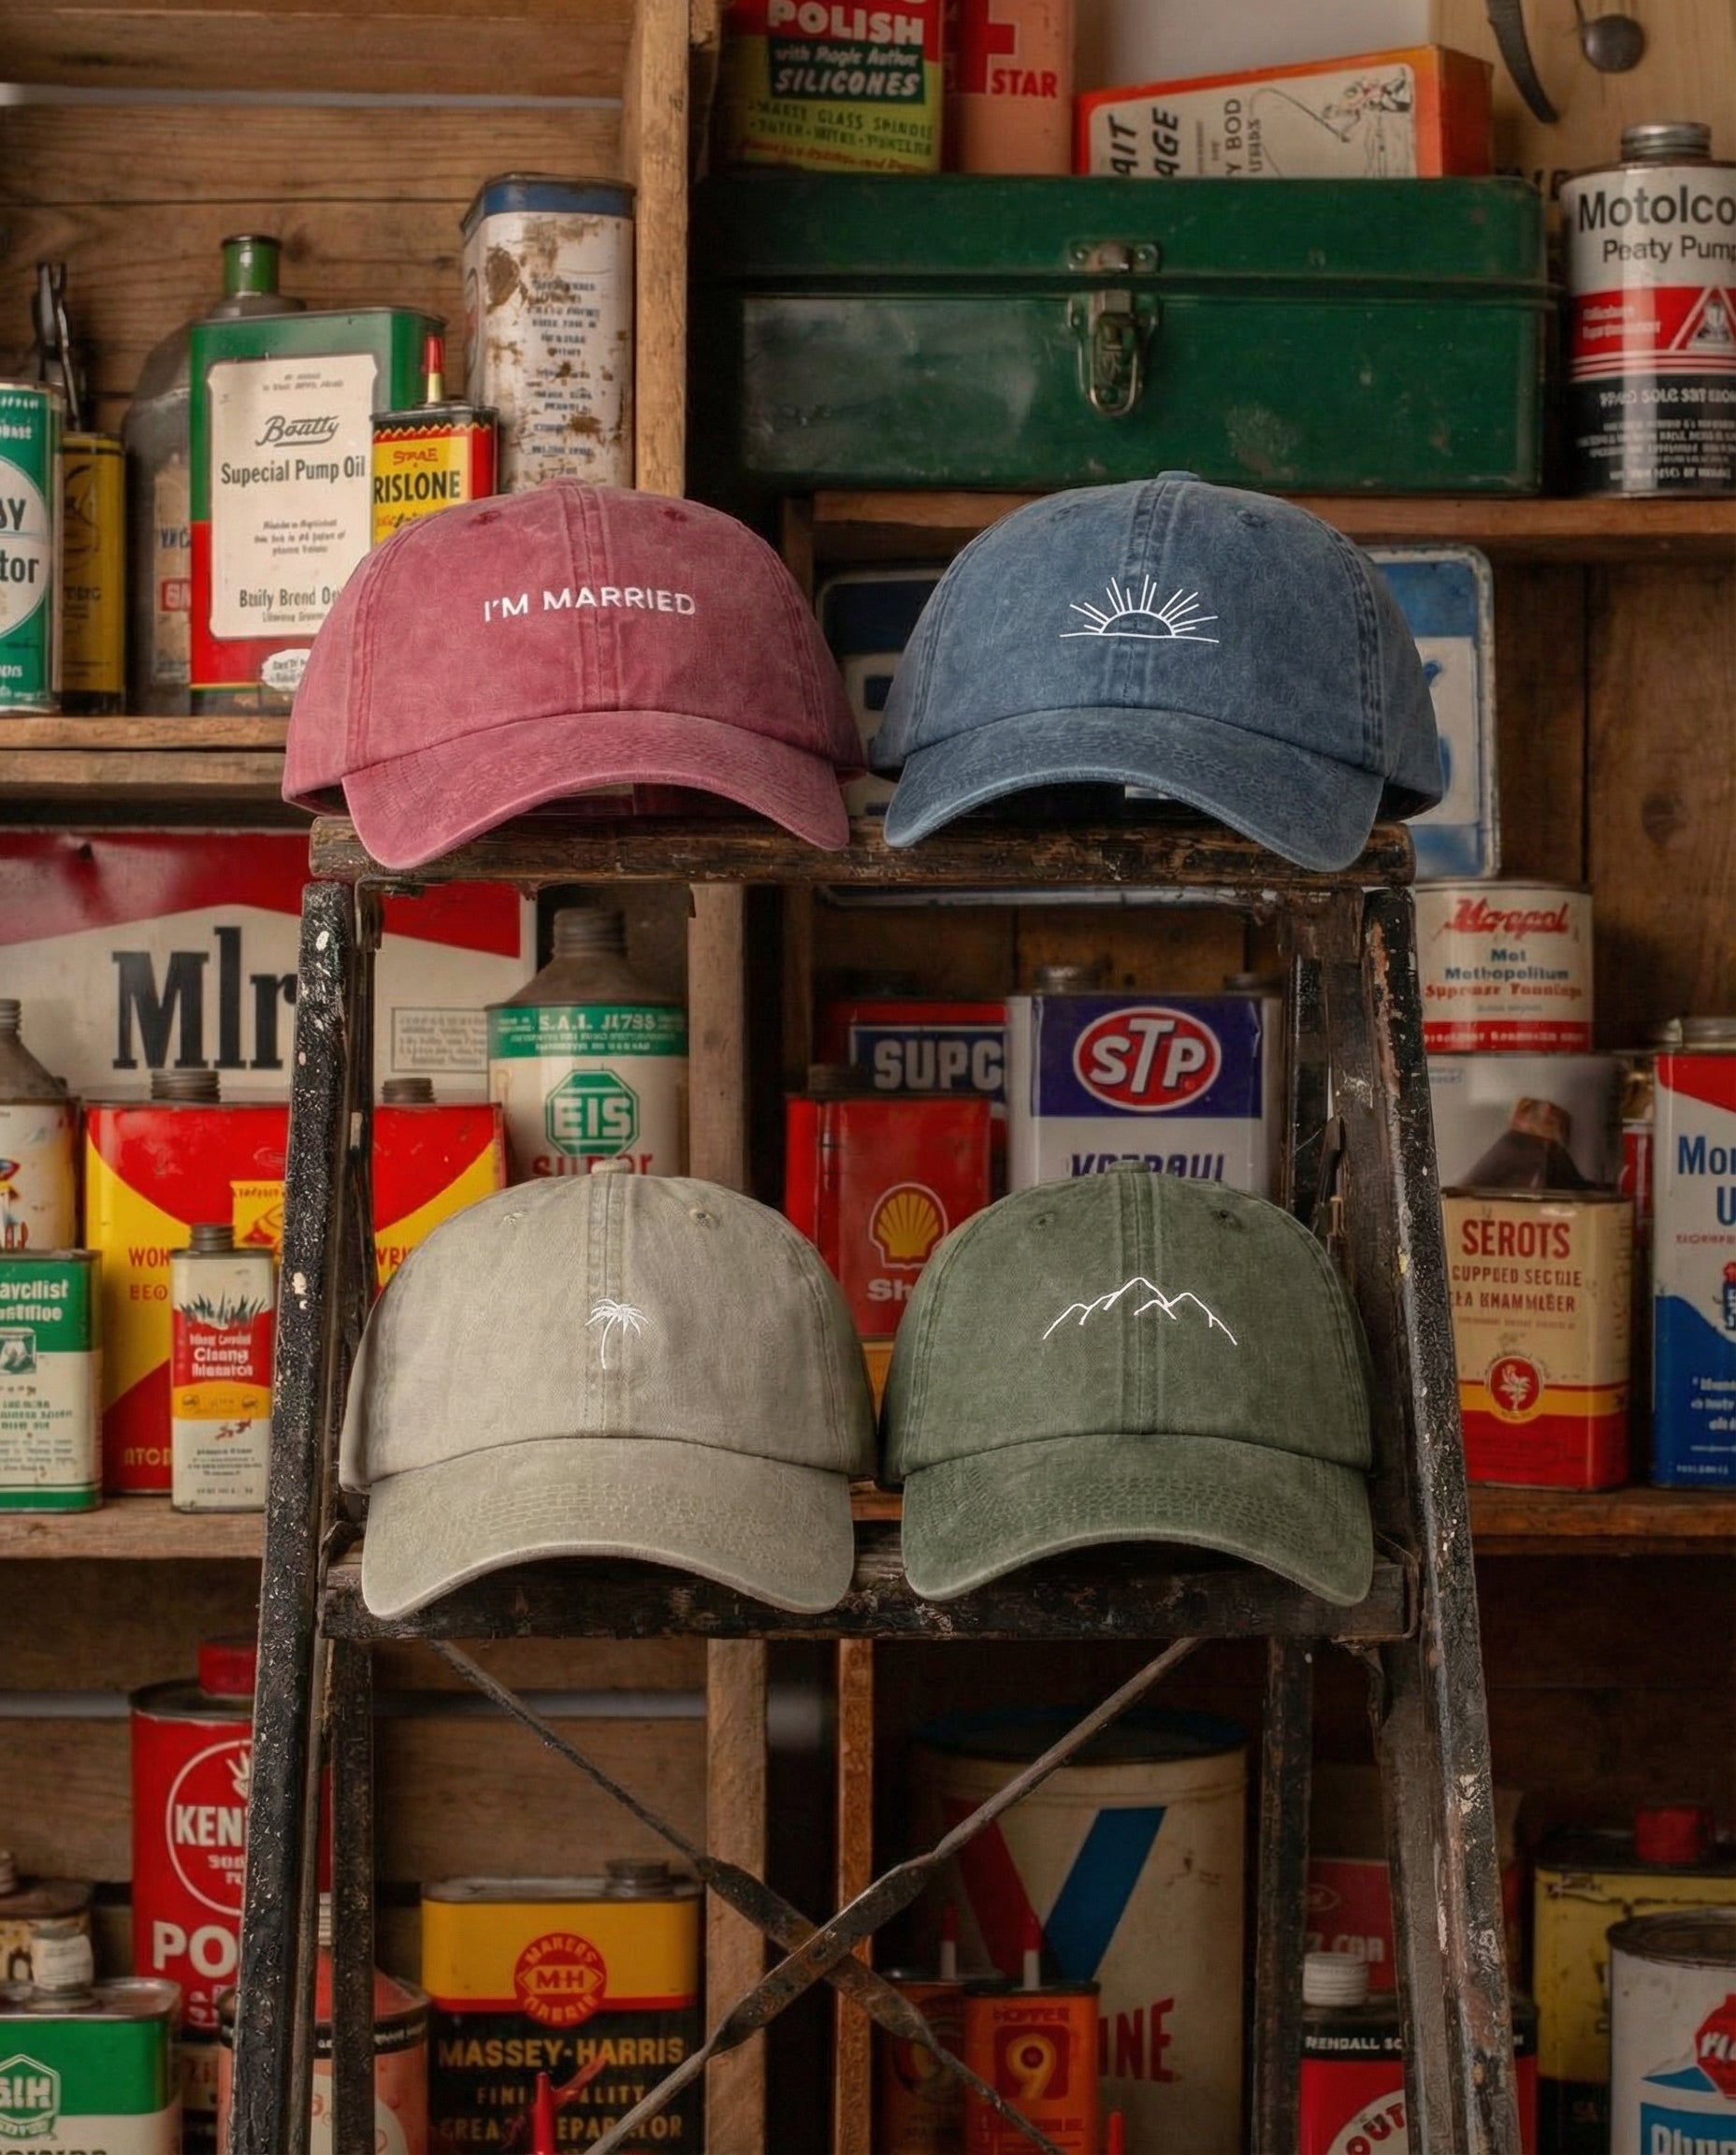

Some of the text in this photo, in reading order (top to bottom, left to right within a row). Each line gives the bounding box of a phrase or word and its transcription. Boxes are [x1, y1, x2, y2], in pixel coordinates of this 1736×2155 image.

[767, 0, 924, 45] POLISH
[774, 67, 920, 96] SILICONES
[991, 67, 1057, 99] STAR
[221, 456, 366, 488] Supecial Pump Oil
[373, 470, 460, 504] RISLONE
[485, 586, 697, 623] I'M MARRIED
[111, 925, 298, 1070] Mlr
[1088, 1018, 1208, 1093] STP
[554, 1097, 631, 1138] EIS
[1462, 1219, 1572, 1260] SEROTS
[1005, 2032, 1058, 2101] 9
